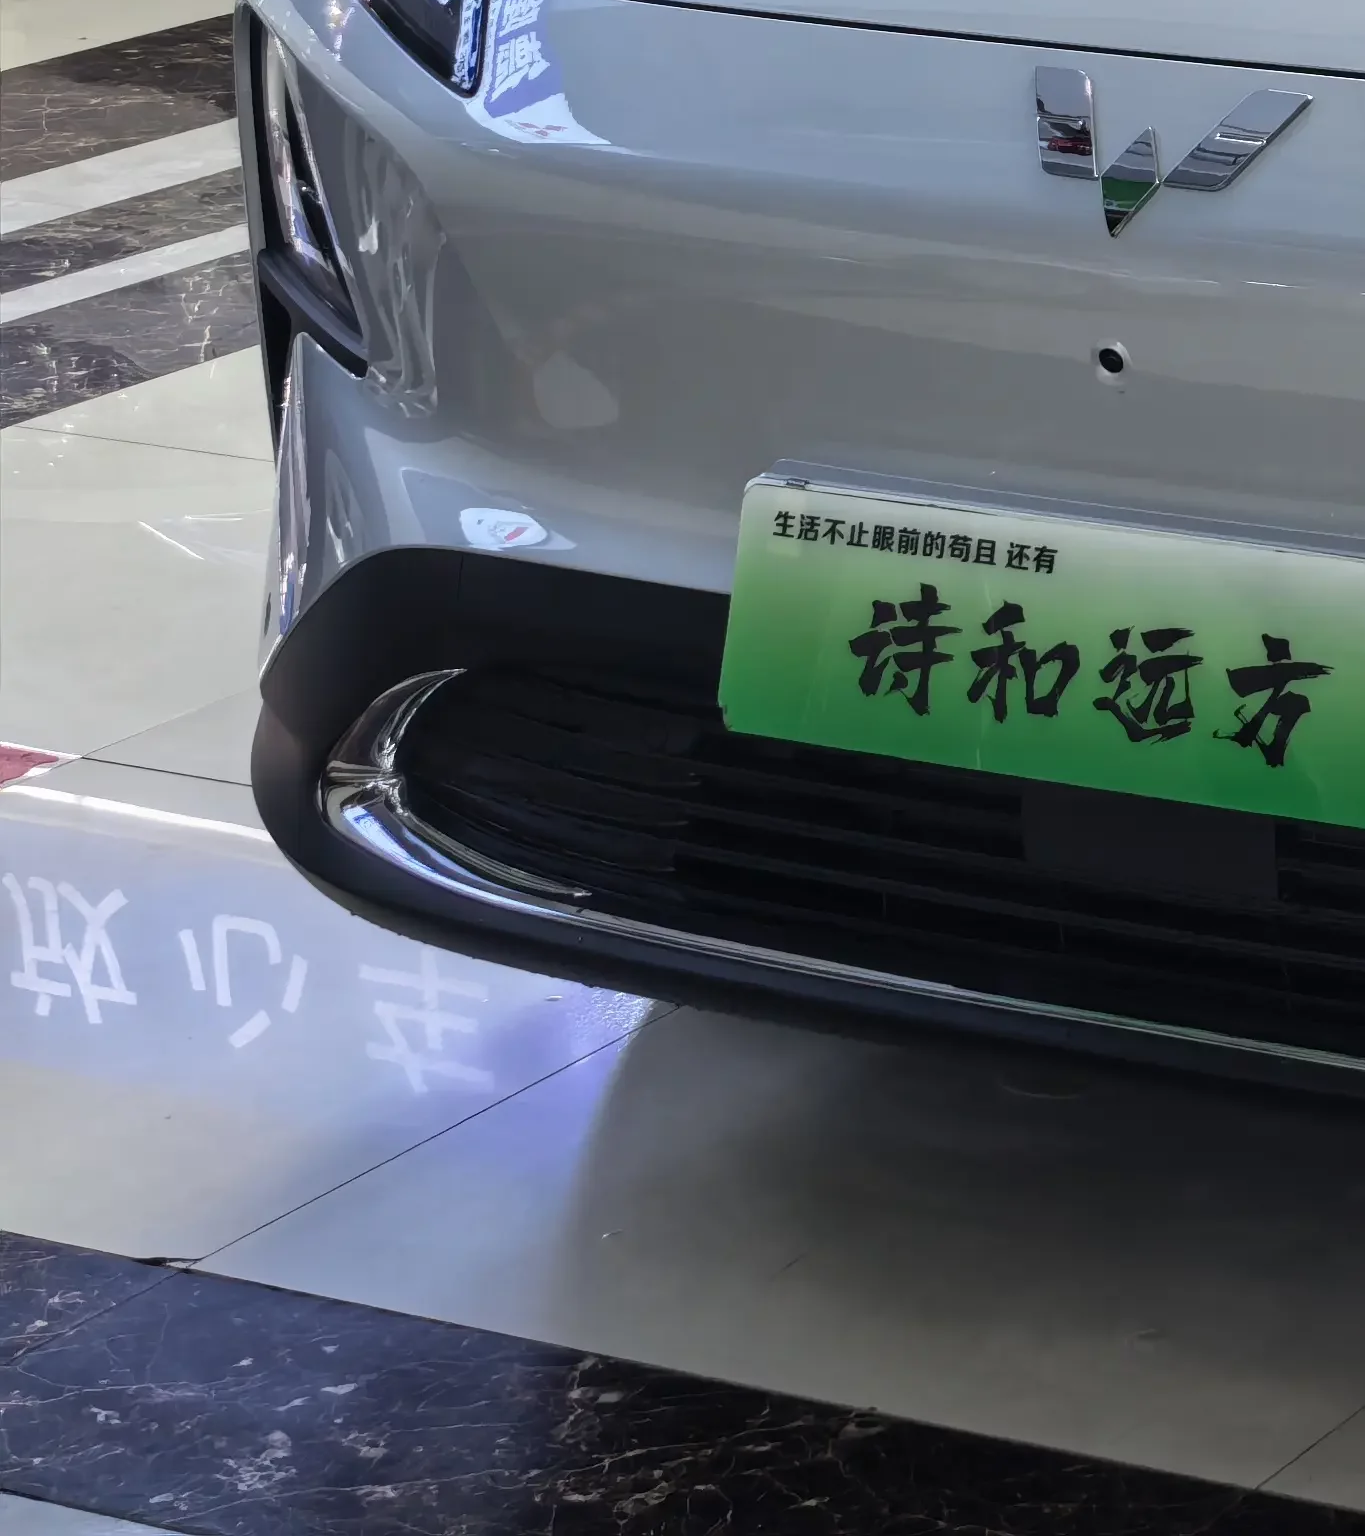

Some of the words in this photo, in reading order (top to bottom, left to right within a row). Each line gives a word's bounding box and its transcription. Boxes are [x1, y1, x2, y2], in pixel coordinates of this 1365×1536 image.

[772, 509, 998, 568] 生活不止眼前的苟且
[1004, 541, 1059, 576] 还有
[847, 582, 1335, 769] 诗和远方
